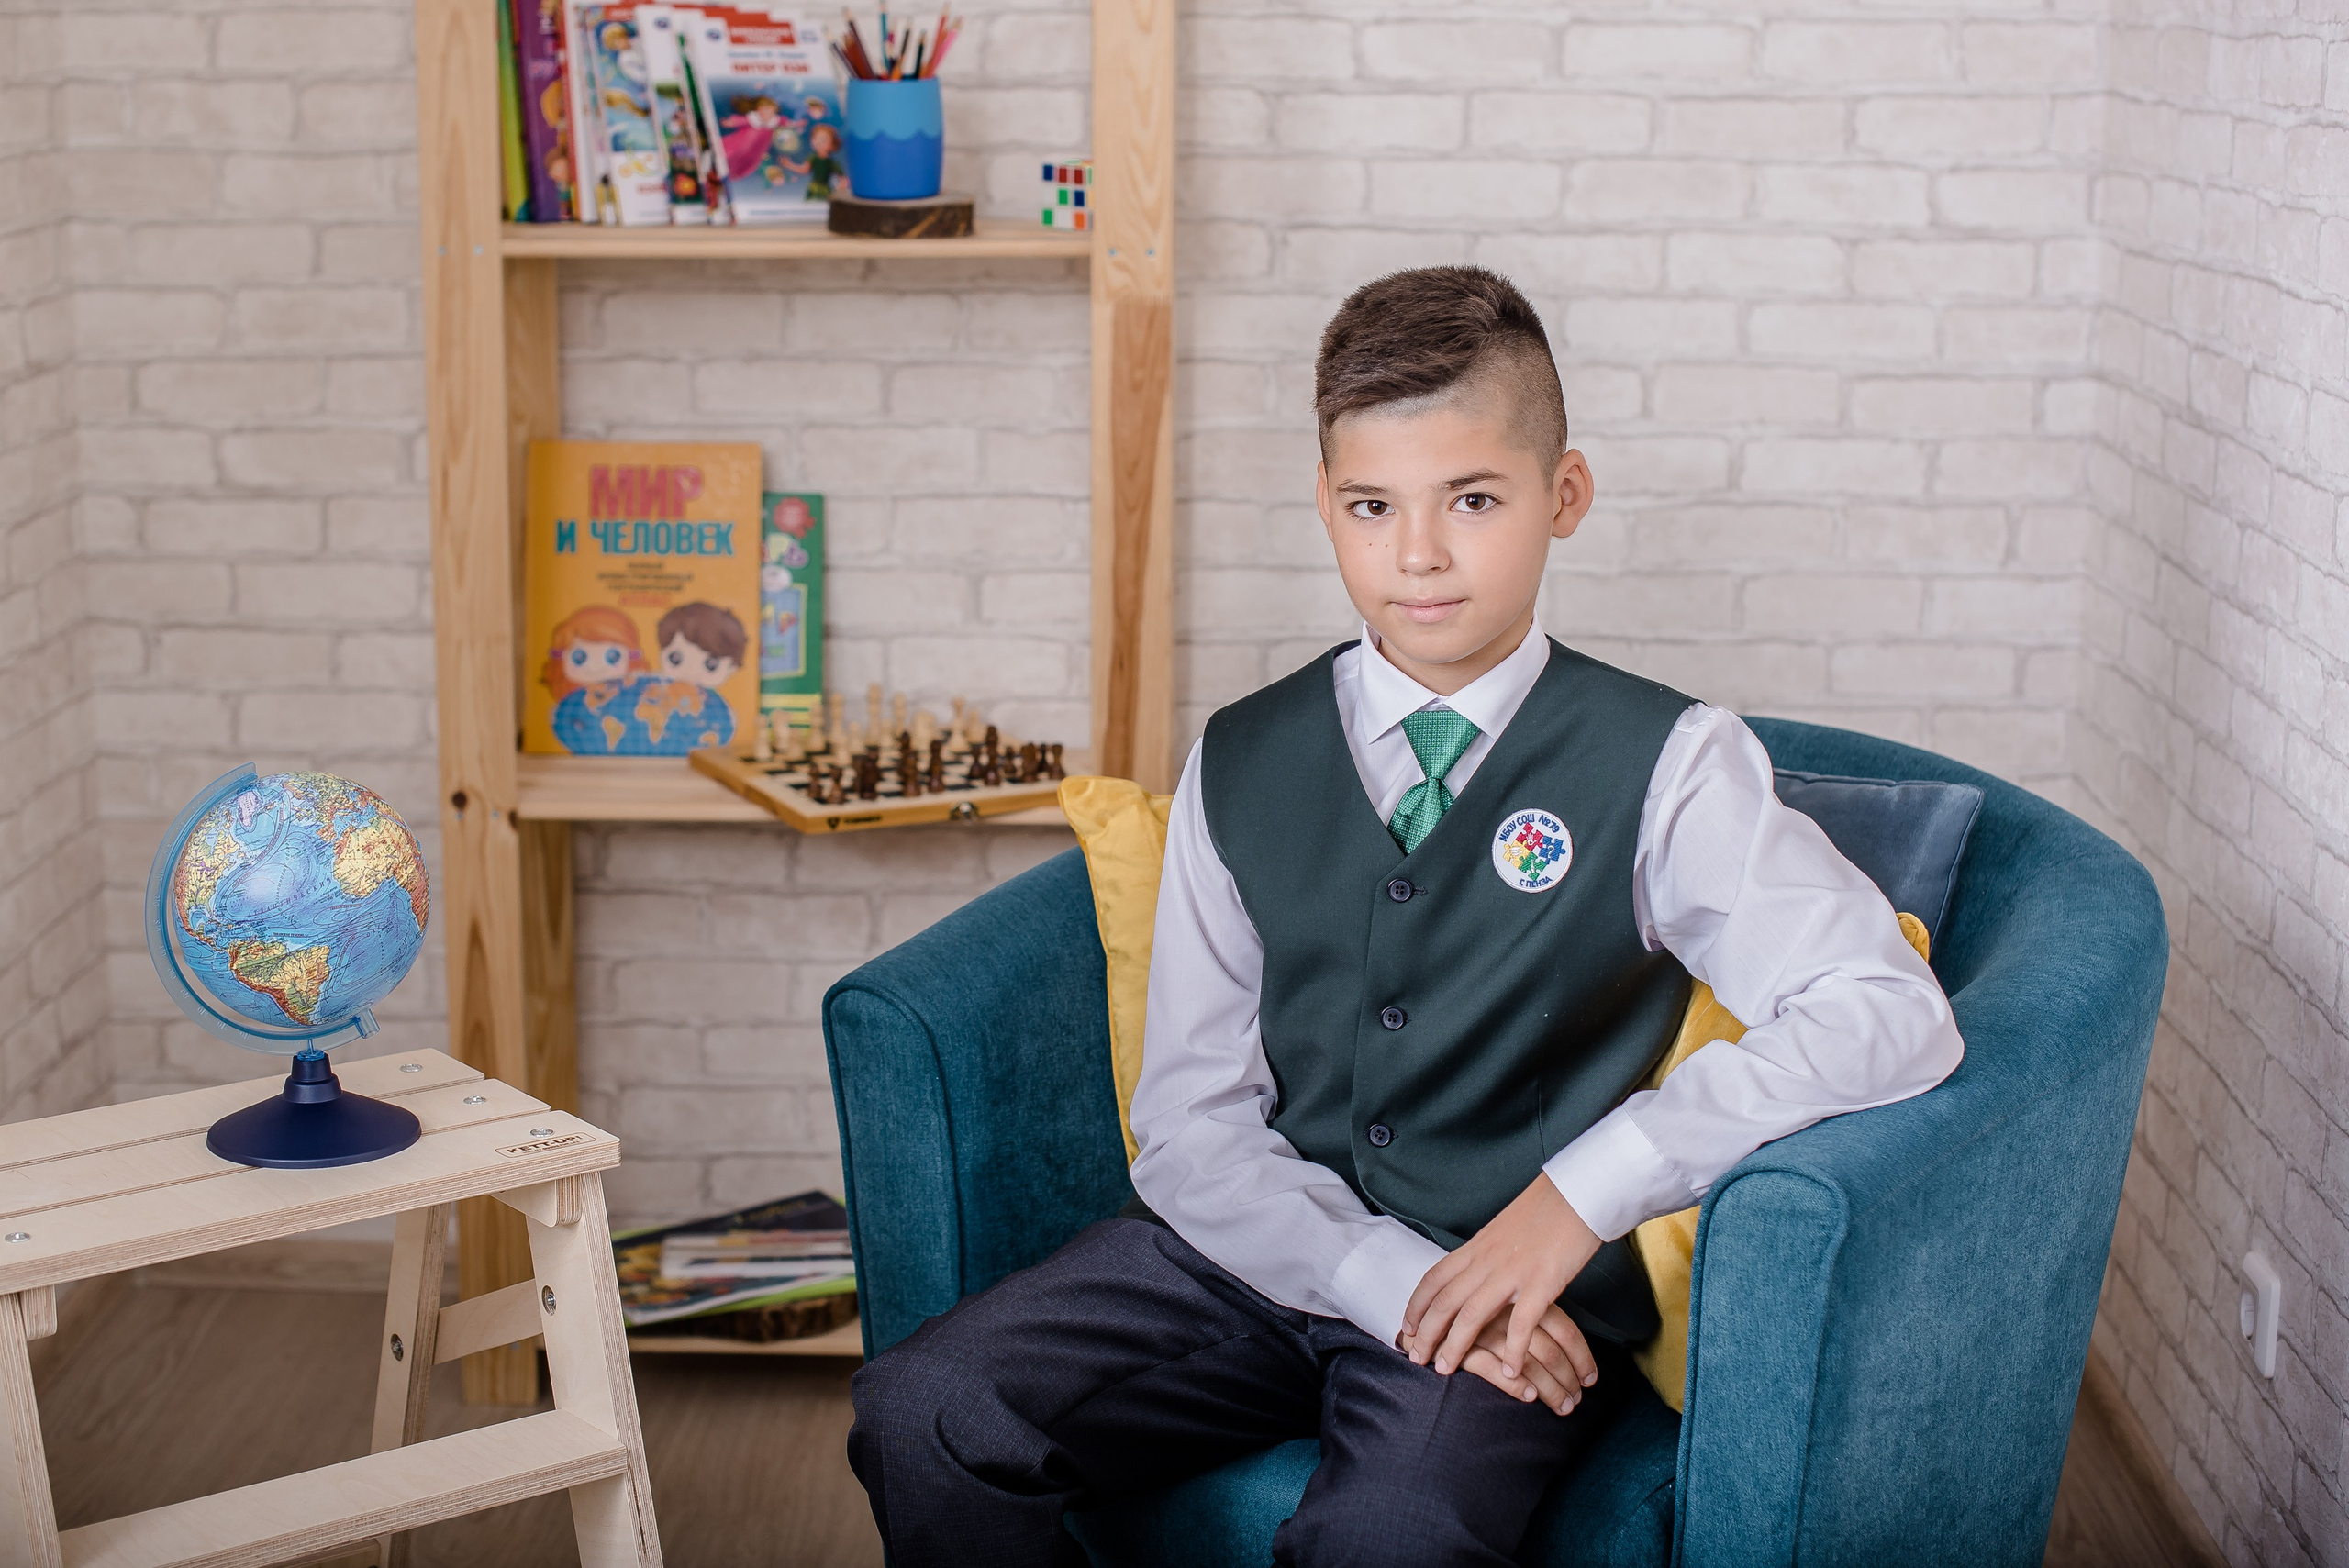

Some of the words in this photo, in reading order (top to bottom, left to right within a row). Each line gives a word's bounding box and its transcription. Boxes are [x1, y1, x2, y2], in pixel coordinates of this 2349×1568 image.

[591, 465, 704, 519] МИР
[555, 520, 576, 554] И
[590, 520, 733, 556] ЧЕЛОВЕК
[1499, 821, 1517, 841] МБОУ
[1517, 814, 1535, 825] СОШ
[1539, 815, 1560, 833] №79
[1525, 876, 1553, 887] ПЕНЗА
[507, 1135, 583, 1153] KETT-UP!
